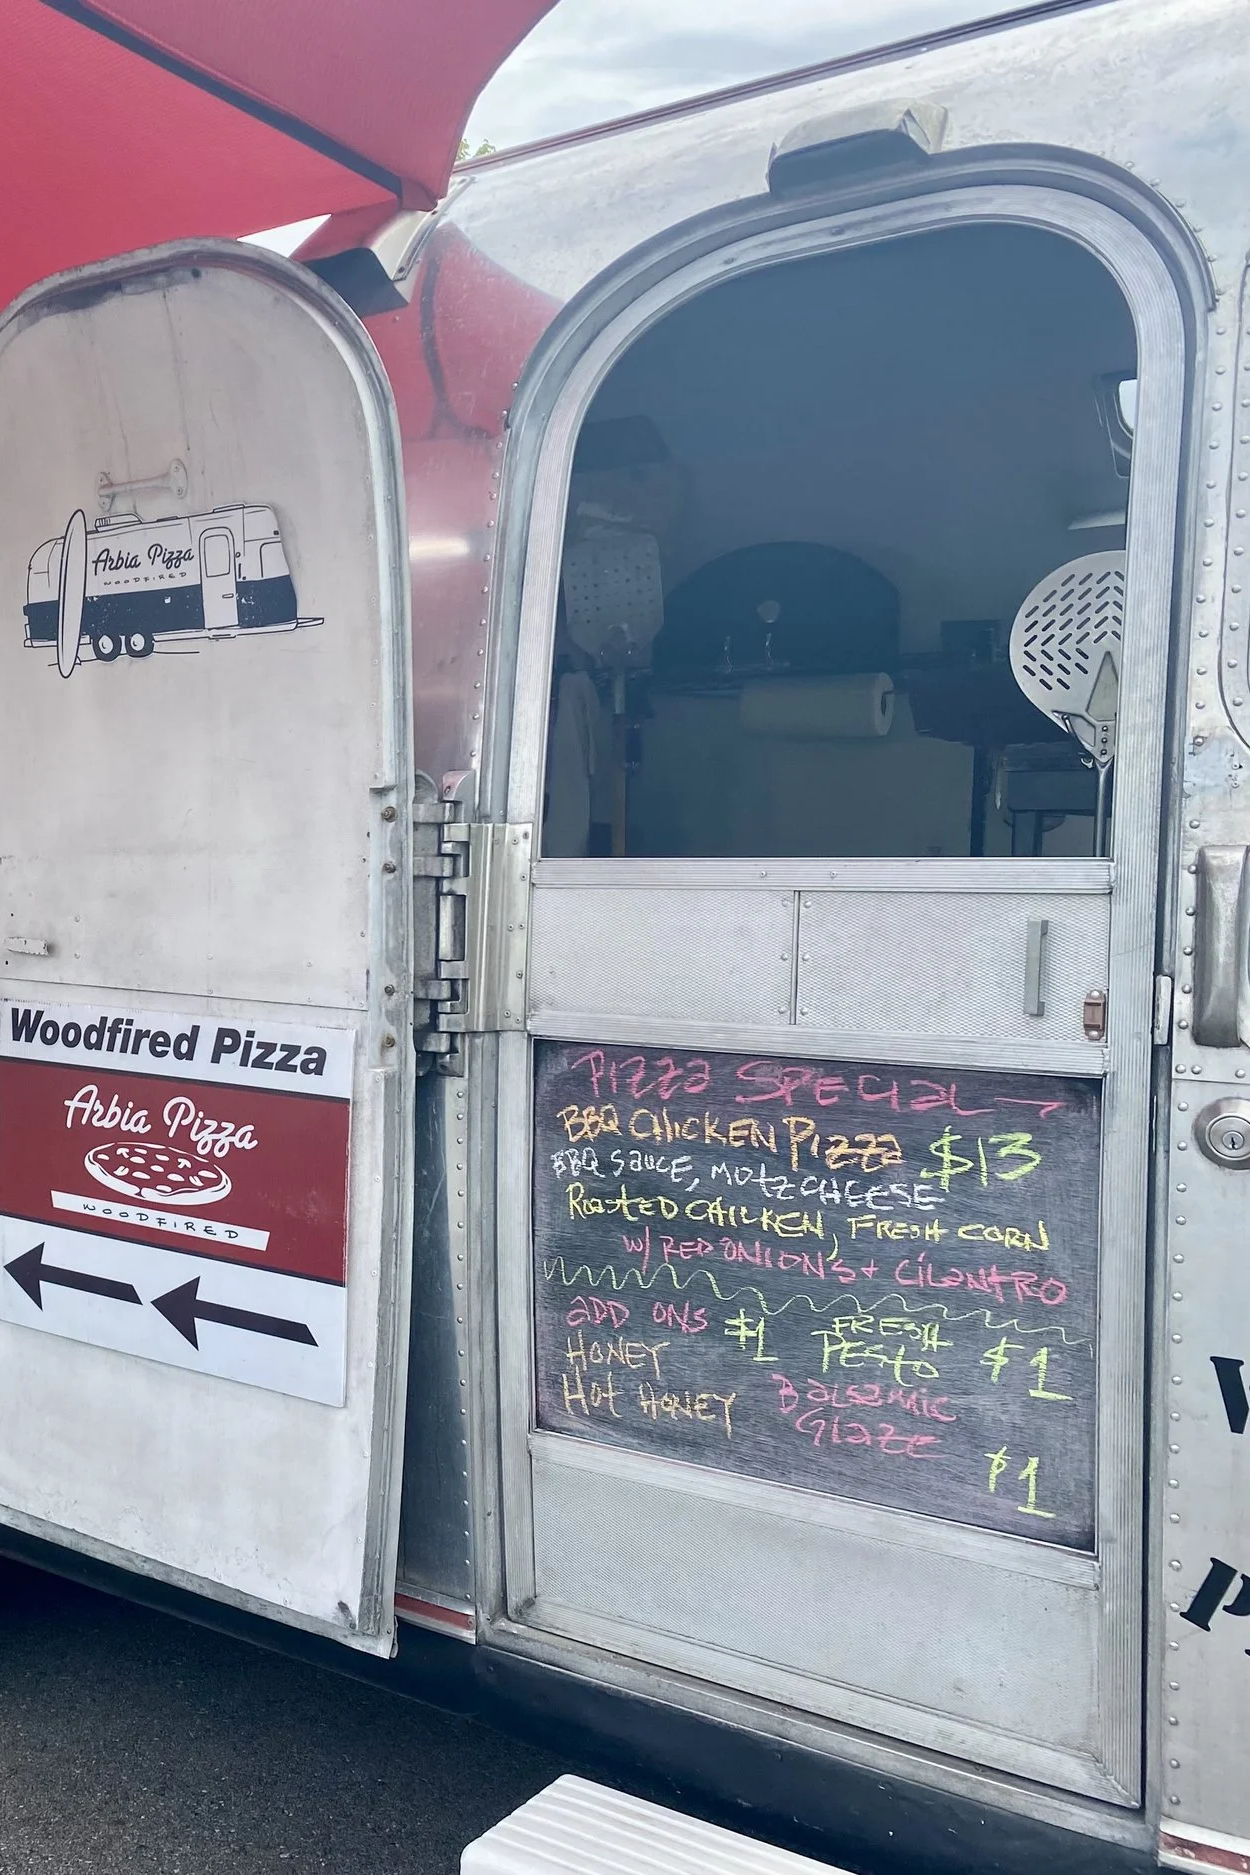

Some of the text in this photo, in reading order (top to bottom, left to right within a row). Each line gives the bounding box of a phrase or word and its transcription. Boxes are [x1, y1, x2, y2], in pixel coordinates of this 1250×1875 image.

[92, 543, 194, 576] Arbia Pizza
[103, 571, 187, 586] WOODFIRED
[10, 1006, 328, 1076] Woodfired Pizza
[63, 1084, 258, 1158] Arbia Pizza
[550, 1146, 605, 1179] BBQ
[556, 1102, 623, 1143] BBQ
[919, 1124, 1043, 1193] $13
[82, 1202, 239, 1240] WOODFIRED
[847, 1213, 949, 1244] FRESH
[957, 1219, 1050, 1252] CORN
[659, 1234, 713, 1264] RED
[831, 1314, 954, 1352] FRESH
[565, 1329, 671, 1381] HONEY
[639, 1380, 738, 1440] HONEY
